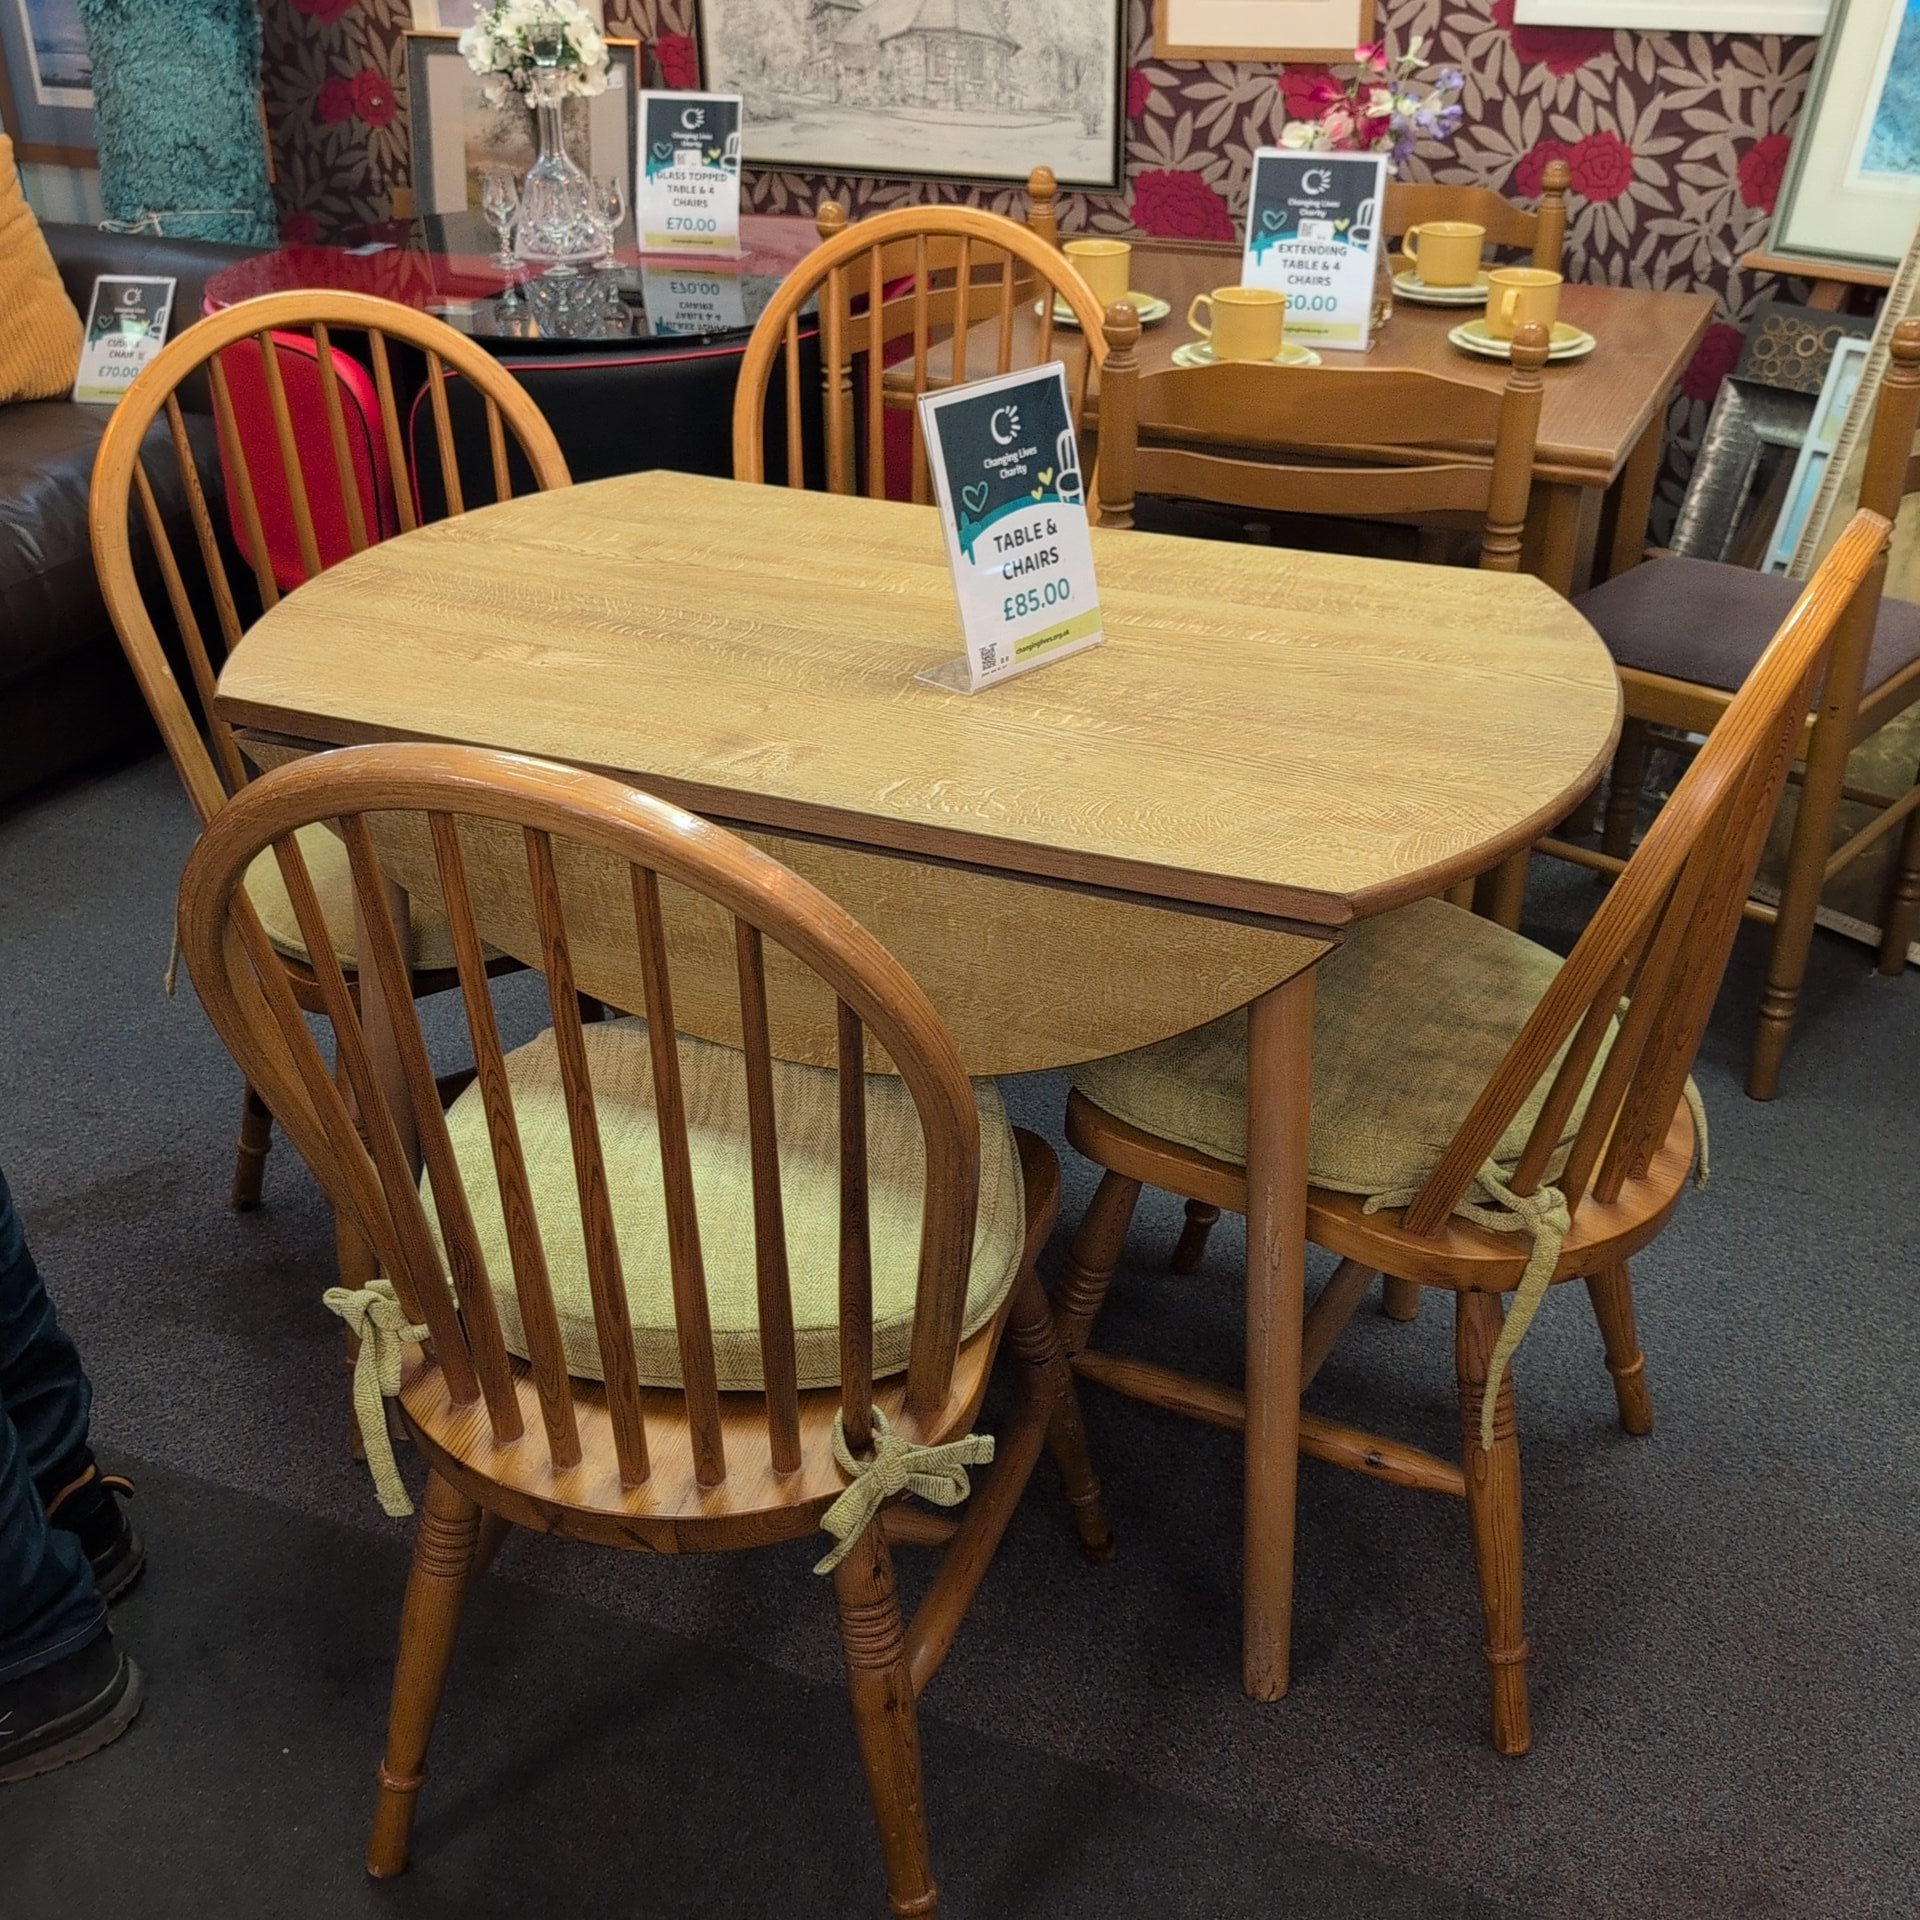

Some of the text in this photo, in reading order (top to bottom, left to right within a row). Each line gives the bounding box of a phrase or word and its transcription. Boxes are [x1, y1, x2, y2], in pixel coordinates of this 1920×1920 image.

[688, 171, 728, 183] TOPPED
[667, 184, 696, 195] TABLE
[673, 198, 708, 209] CHAIRS
[666, 216, 717, 232] £70.00
[1278, 243, 1348, 257] EXTENDING
[1282, 259, 1341, 271] TABLE & 4
[1287, 275, 1332, 287] CHAIRS
[98, 366, 139, 378] £70.00
[983, 446, 1038, 469] Changing Lives
[1000, 464, 1027, 479] Charity
[993, 518, 1058, 553] TABLE &
[1002, 546, 1059, 580] CHAIRS
[1004, 577, 1070, 621] £85.00
